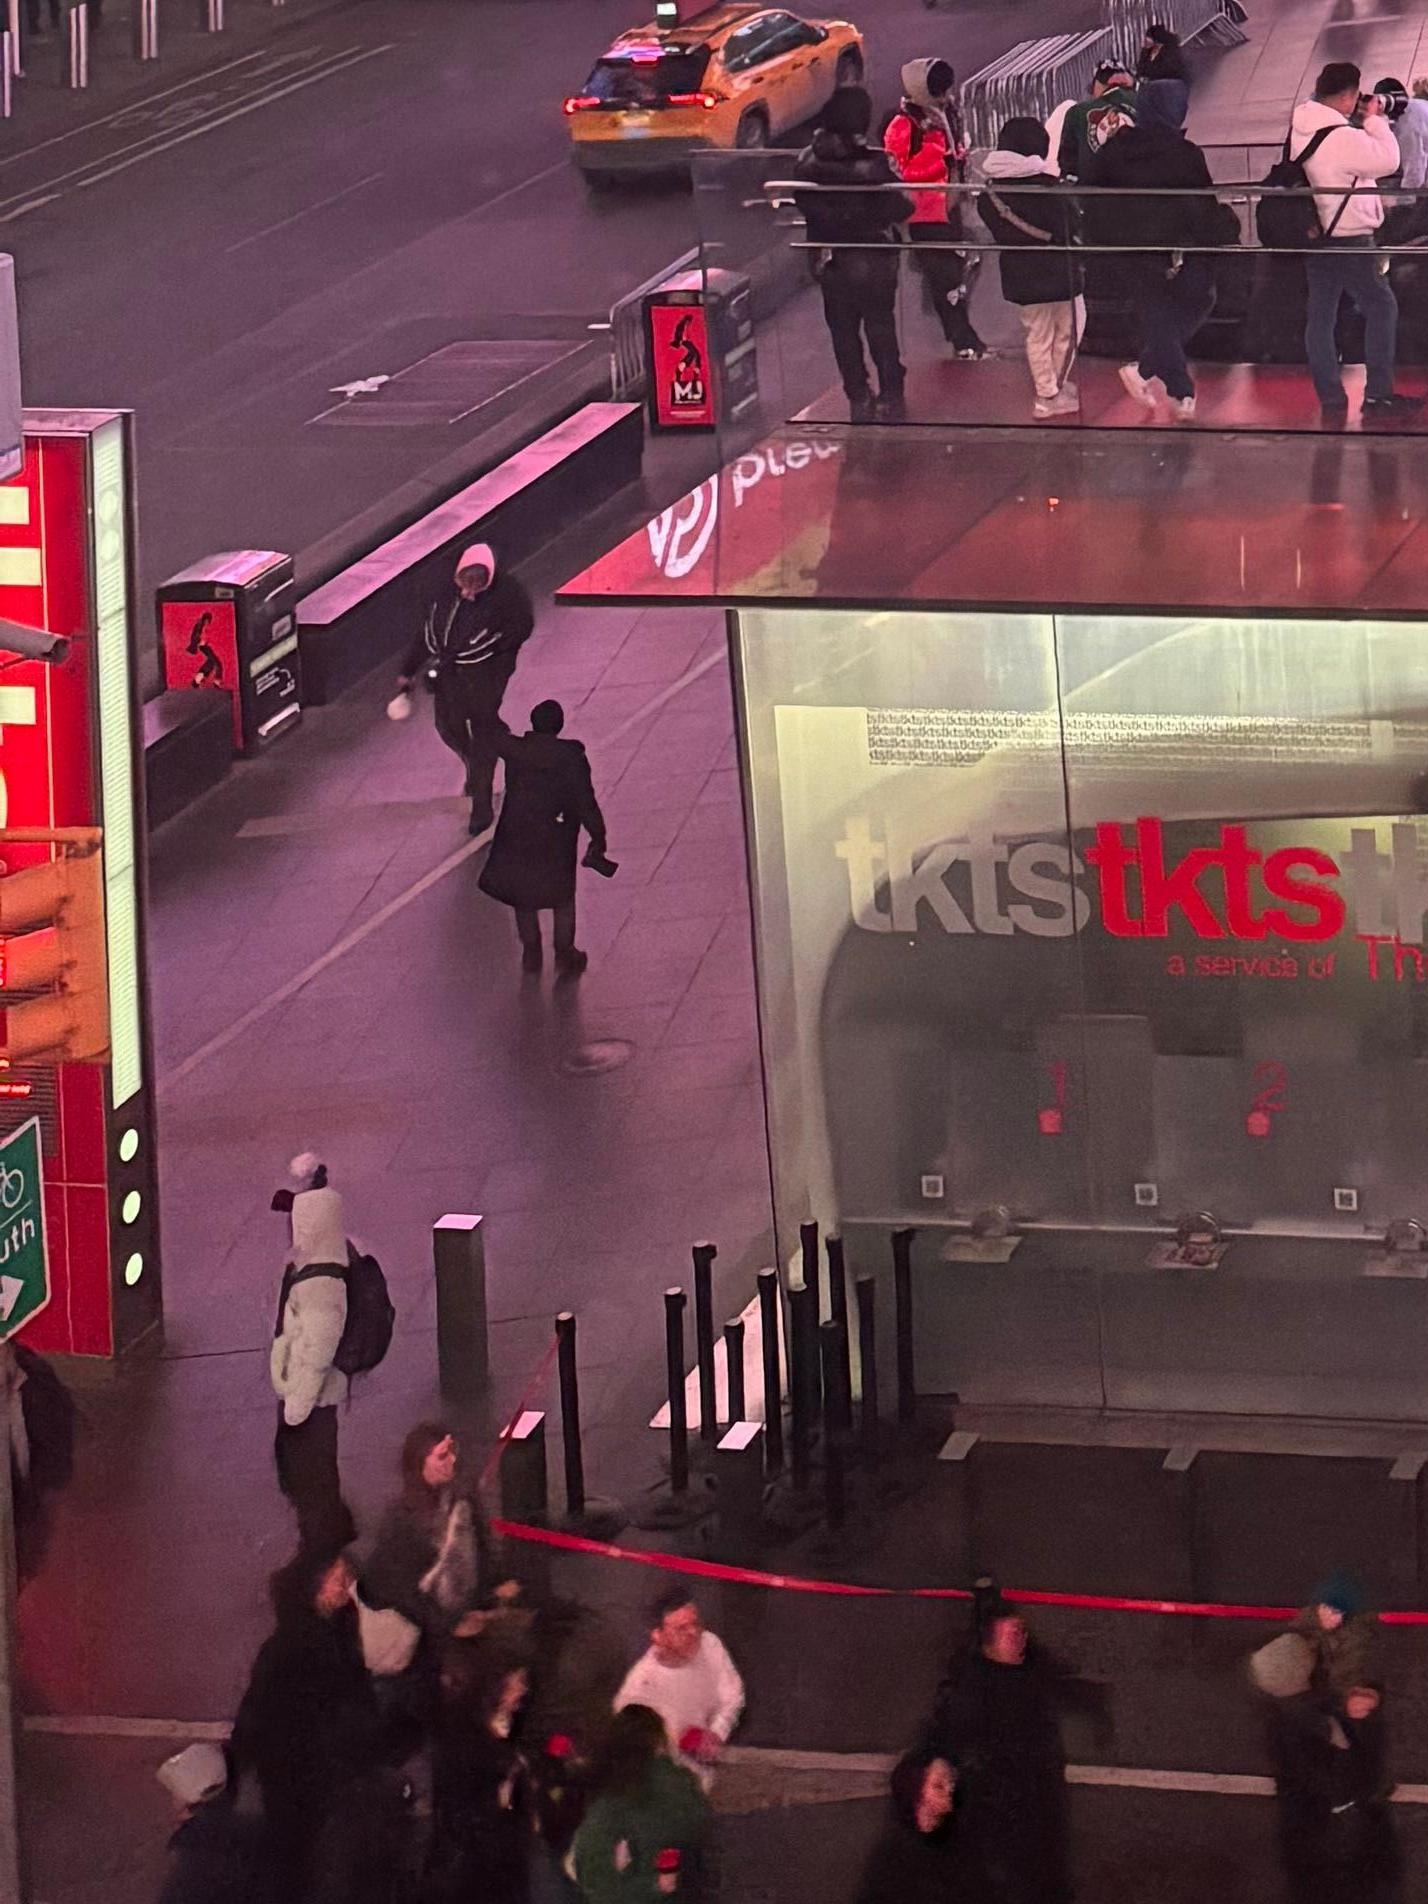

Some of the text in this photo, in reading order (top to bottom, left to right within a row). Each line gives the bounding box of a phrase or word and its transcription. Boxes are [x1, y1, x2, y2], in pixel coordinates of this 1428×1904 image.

[674, 383, 704, 402] MJ
[1086, 816, 1346, 940] tkts
[1167, 954, 1184, 977] a
[1193, 951, 1299, 979] service
[1307, 949, 1335, 979] of
[1254, 1061, 1287, 1110] 2
